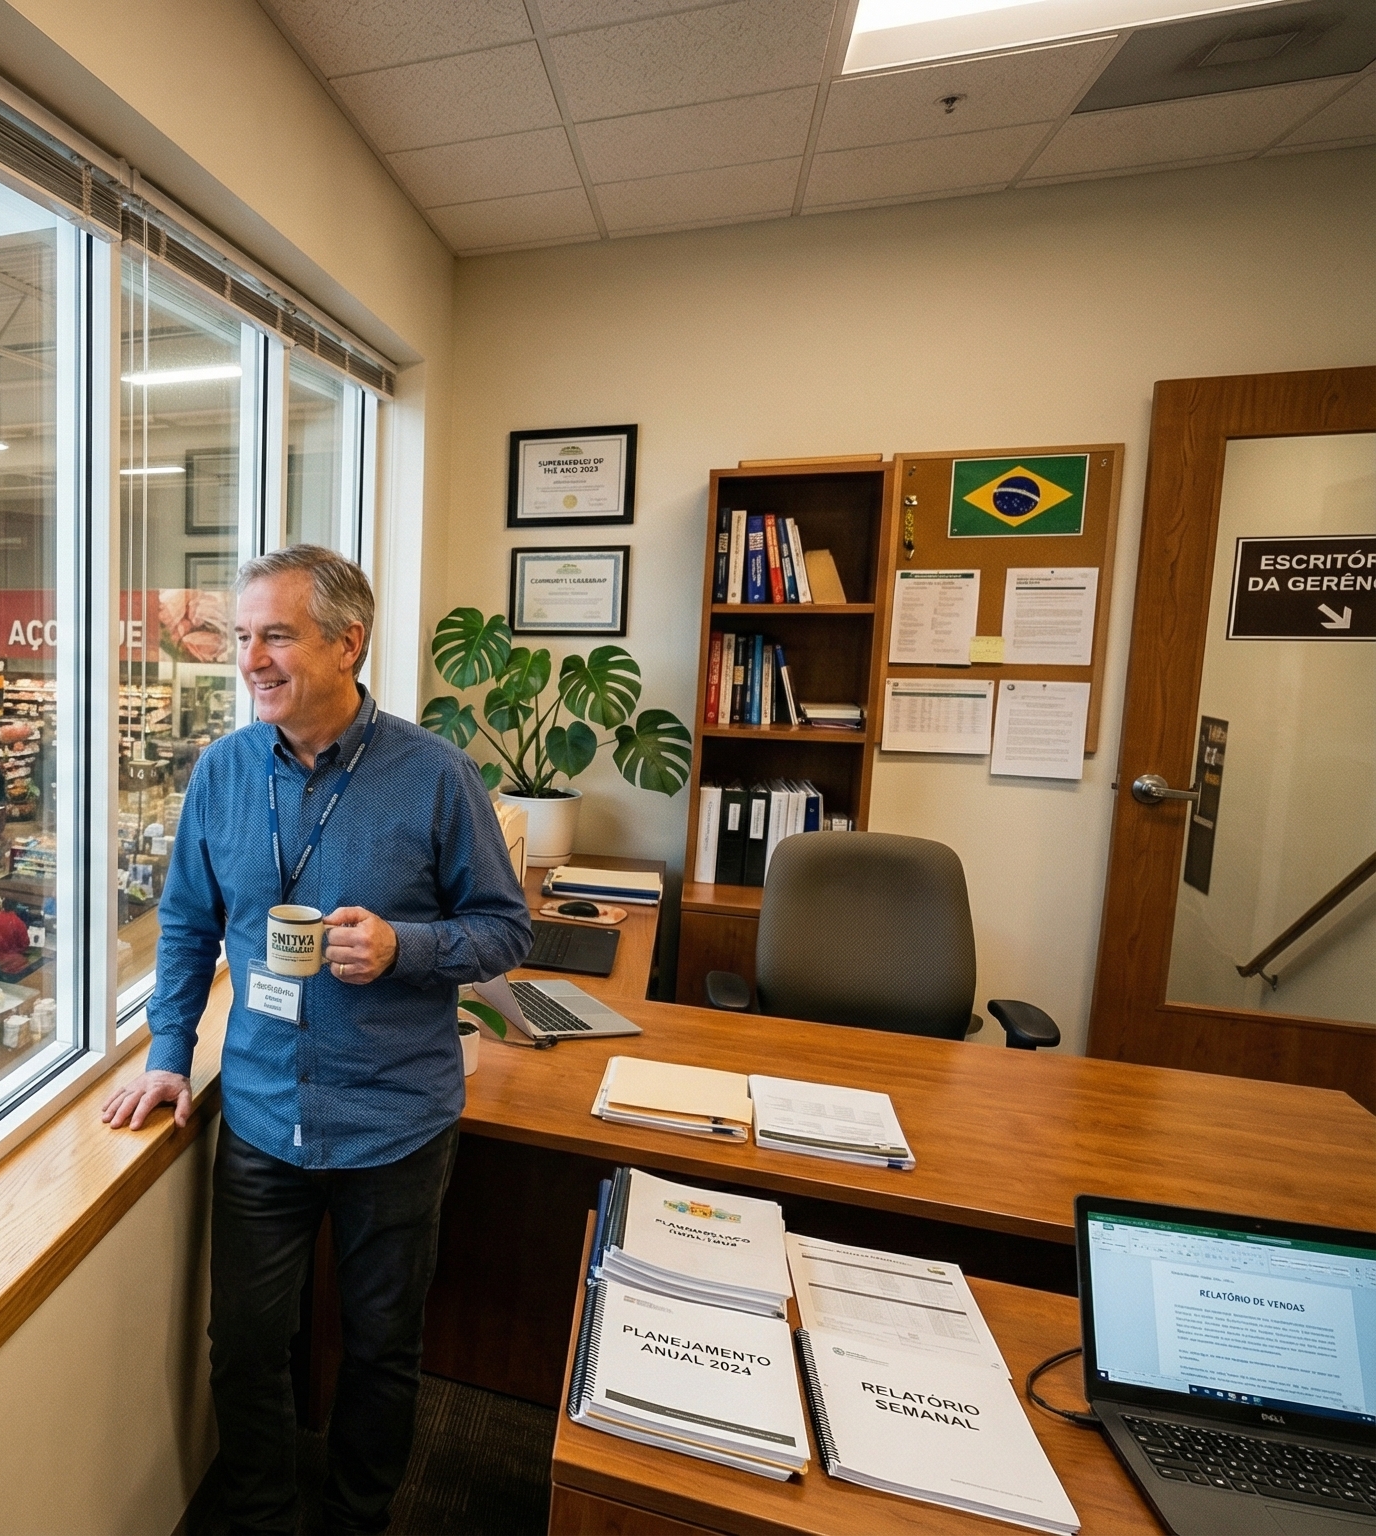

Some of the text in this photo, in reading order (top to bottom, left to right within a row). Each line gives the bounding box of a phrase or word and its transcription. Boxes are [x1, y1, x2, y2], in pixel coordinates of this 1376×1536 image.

[579, 465, 599, 473] 2023
[1247, 572, 1376, 592] DA GERÊN
[1199, 1289, 1306, 1312] RELATÓRIO DE VENDAS
[622, 1324, 771, 1367] PLANEJAMENTO
[640, 1343, 752, 1376] ANUAL 2024
[861, 1381, 980, 1416] RELATÓRIO
[875, 1399, 980, 1431] SEMANAL
